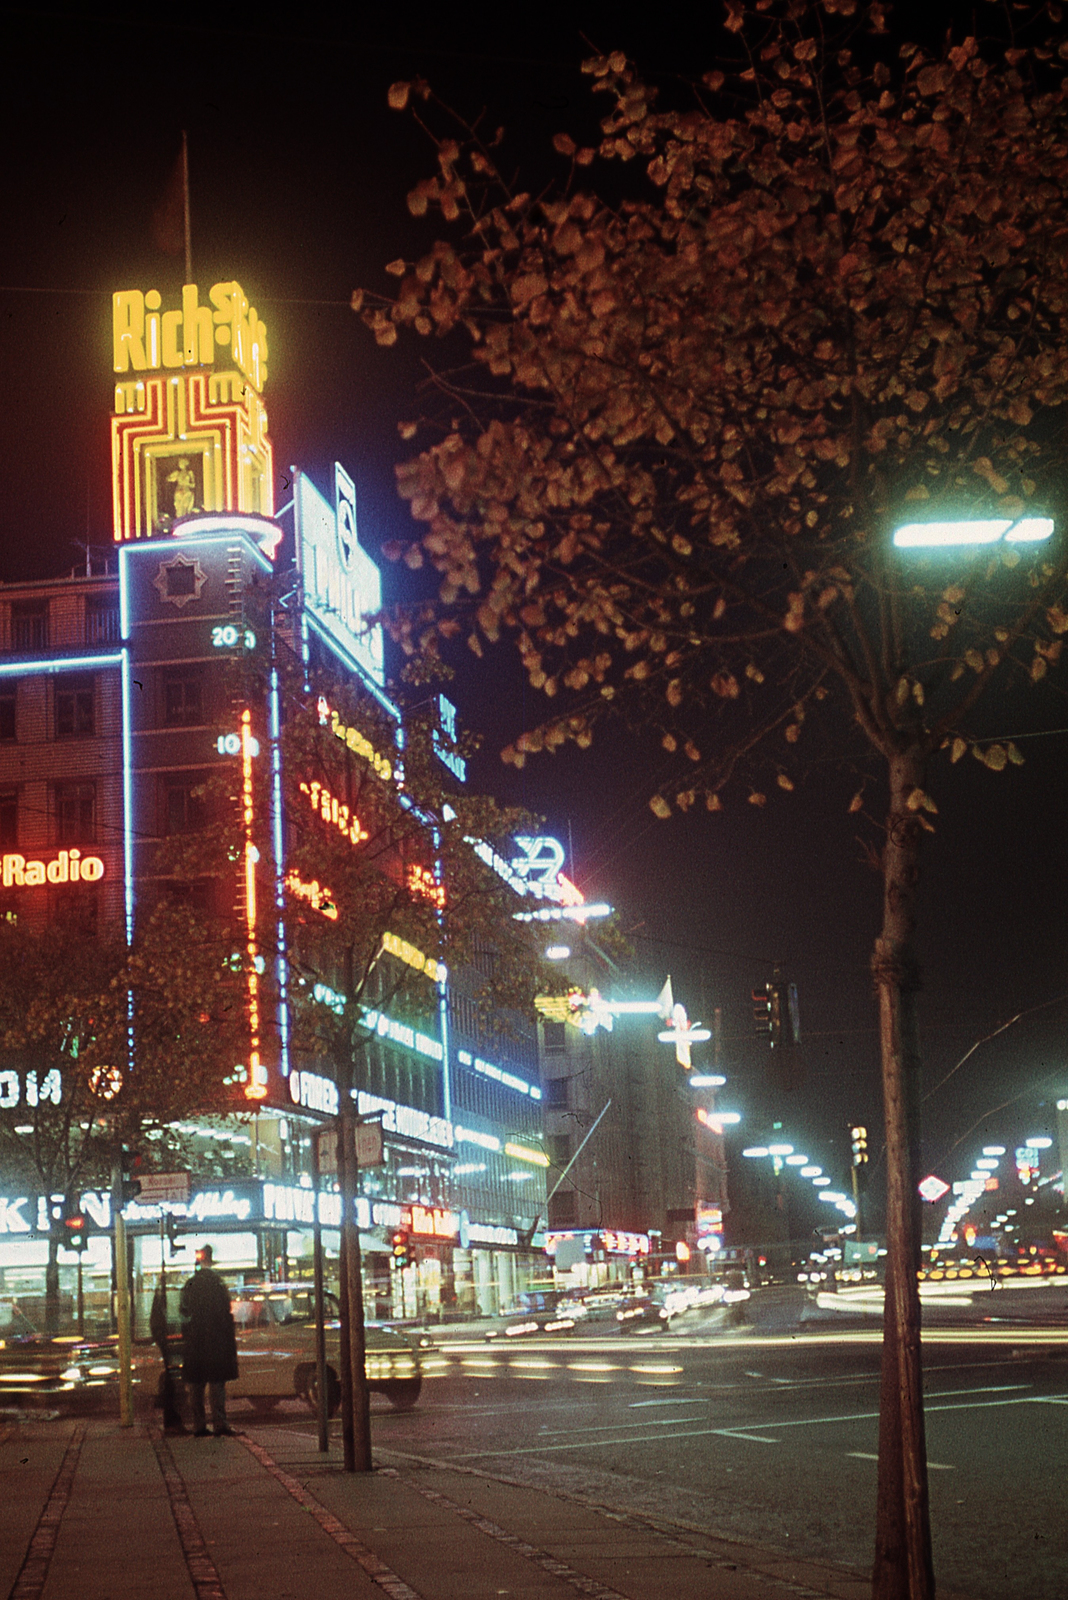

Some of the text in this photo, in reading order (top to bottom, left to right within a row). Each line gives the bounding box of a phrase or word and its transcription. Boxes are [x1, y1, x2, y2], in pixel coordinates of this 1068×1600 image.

[212, 626, 237, 647] 20
[217, 734, 241, 754] 10
[3, 848, 104, 887] Radio
